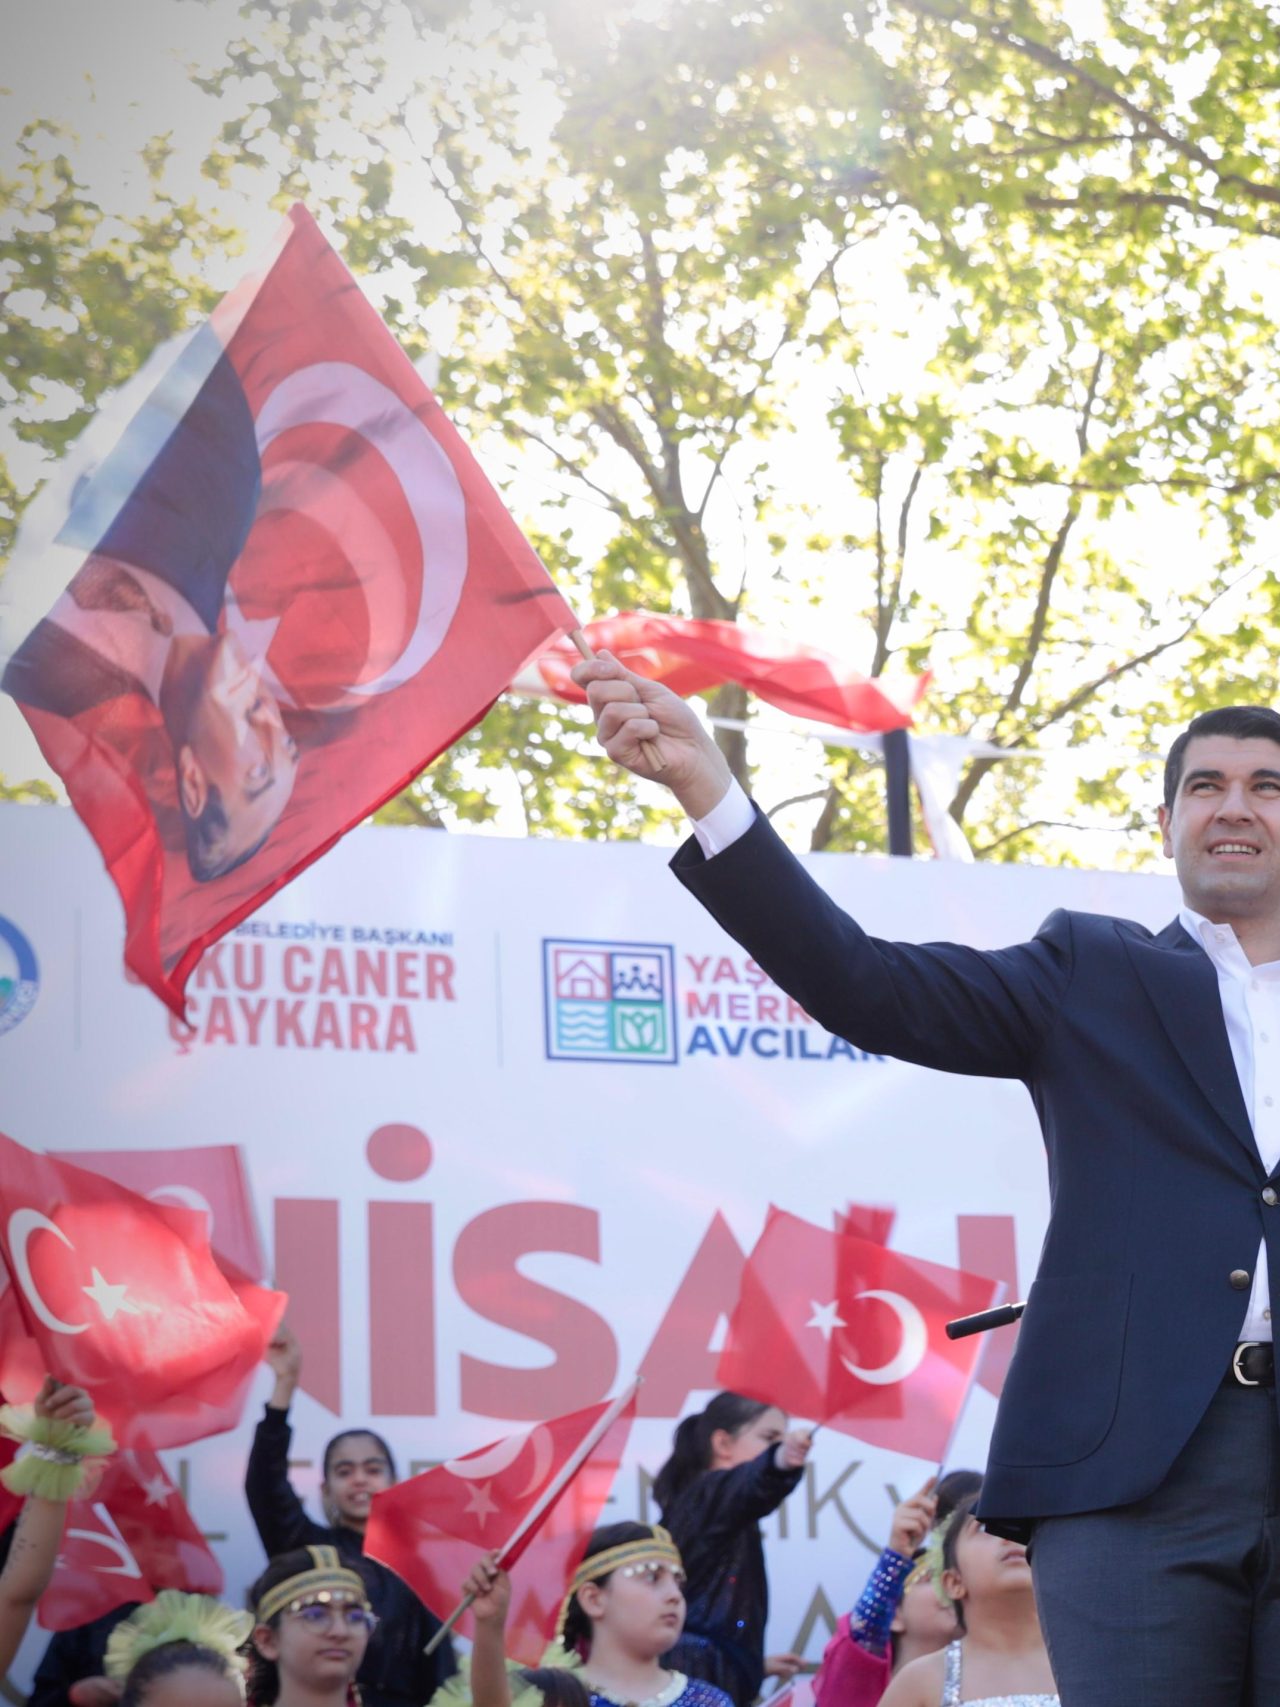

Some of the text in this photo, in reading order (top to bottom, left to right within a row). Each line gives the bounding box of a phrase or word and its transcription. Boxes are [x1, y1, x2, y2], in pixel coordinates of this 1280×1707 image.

[351, 924, 454, 947] BAŞKANI
[282, 945, 458, 1003] CANER
[168, 996, 418, 1056] ÇAYKARA
[685, 991, 813, 1024] MERK
[685, 1025, 888, 1063] AVCILA
